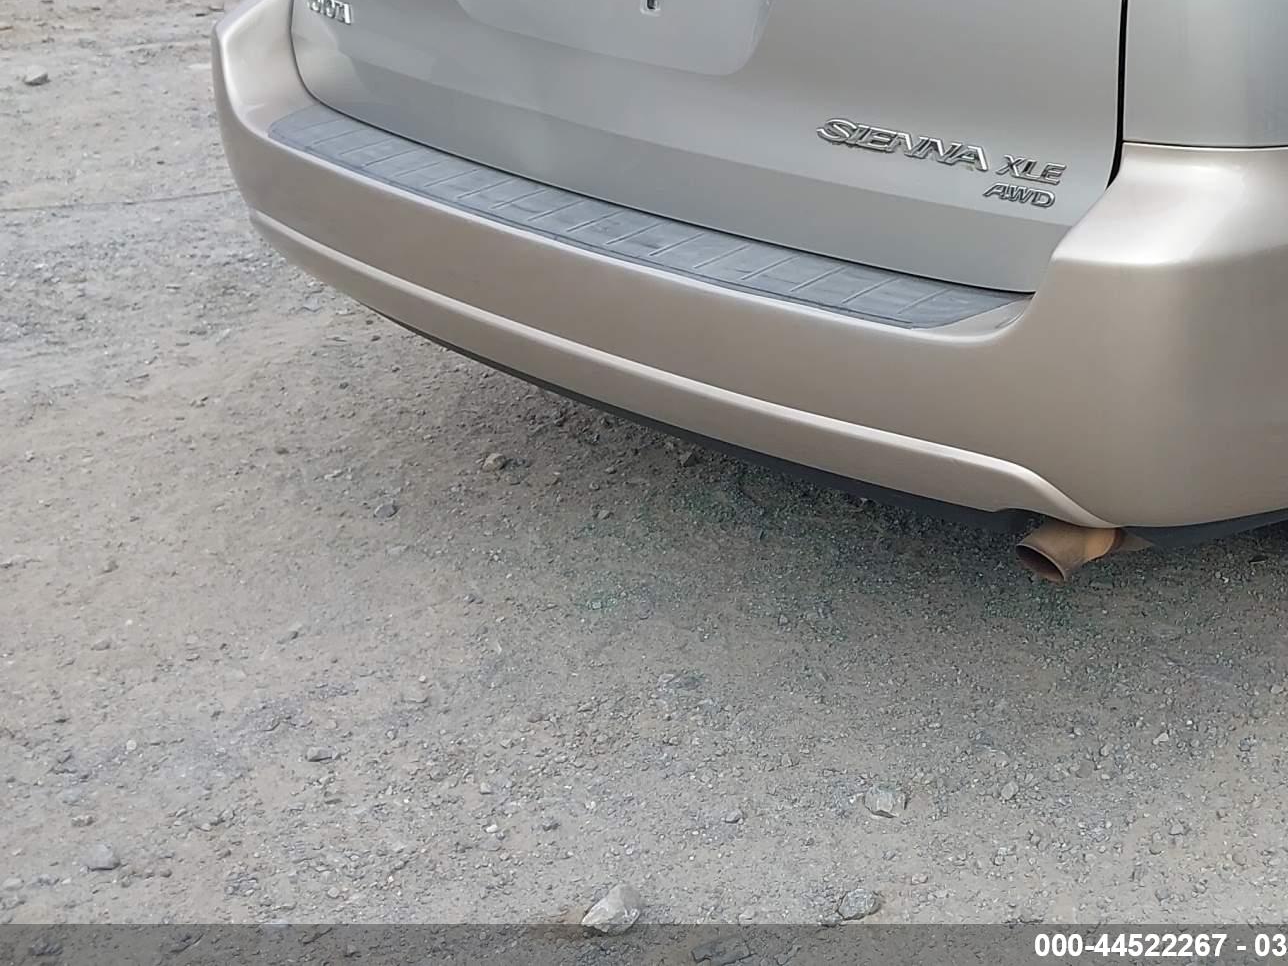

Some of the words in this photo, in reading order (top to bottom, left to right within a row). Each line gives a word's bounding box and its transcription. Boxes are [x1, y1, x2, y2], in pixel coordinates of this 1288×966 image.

[816, 117, 989, 172] SIENNA
[995, 153, 1067, 185] XLE
[982, 181, 1056, 209] AWD
